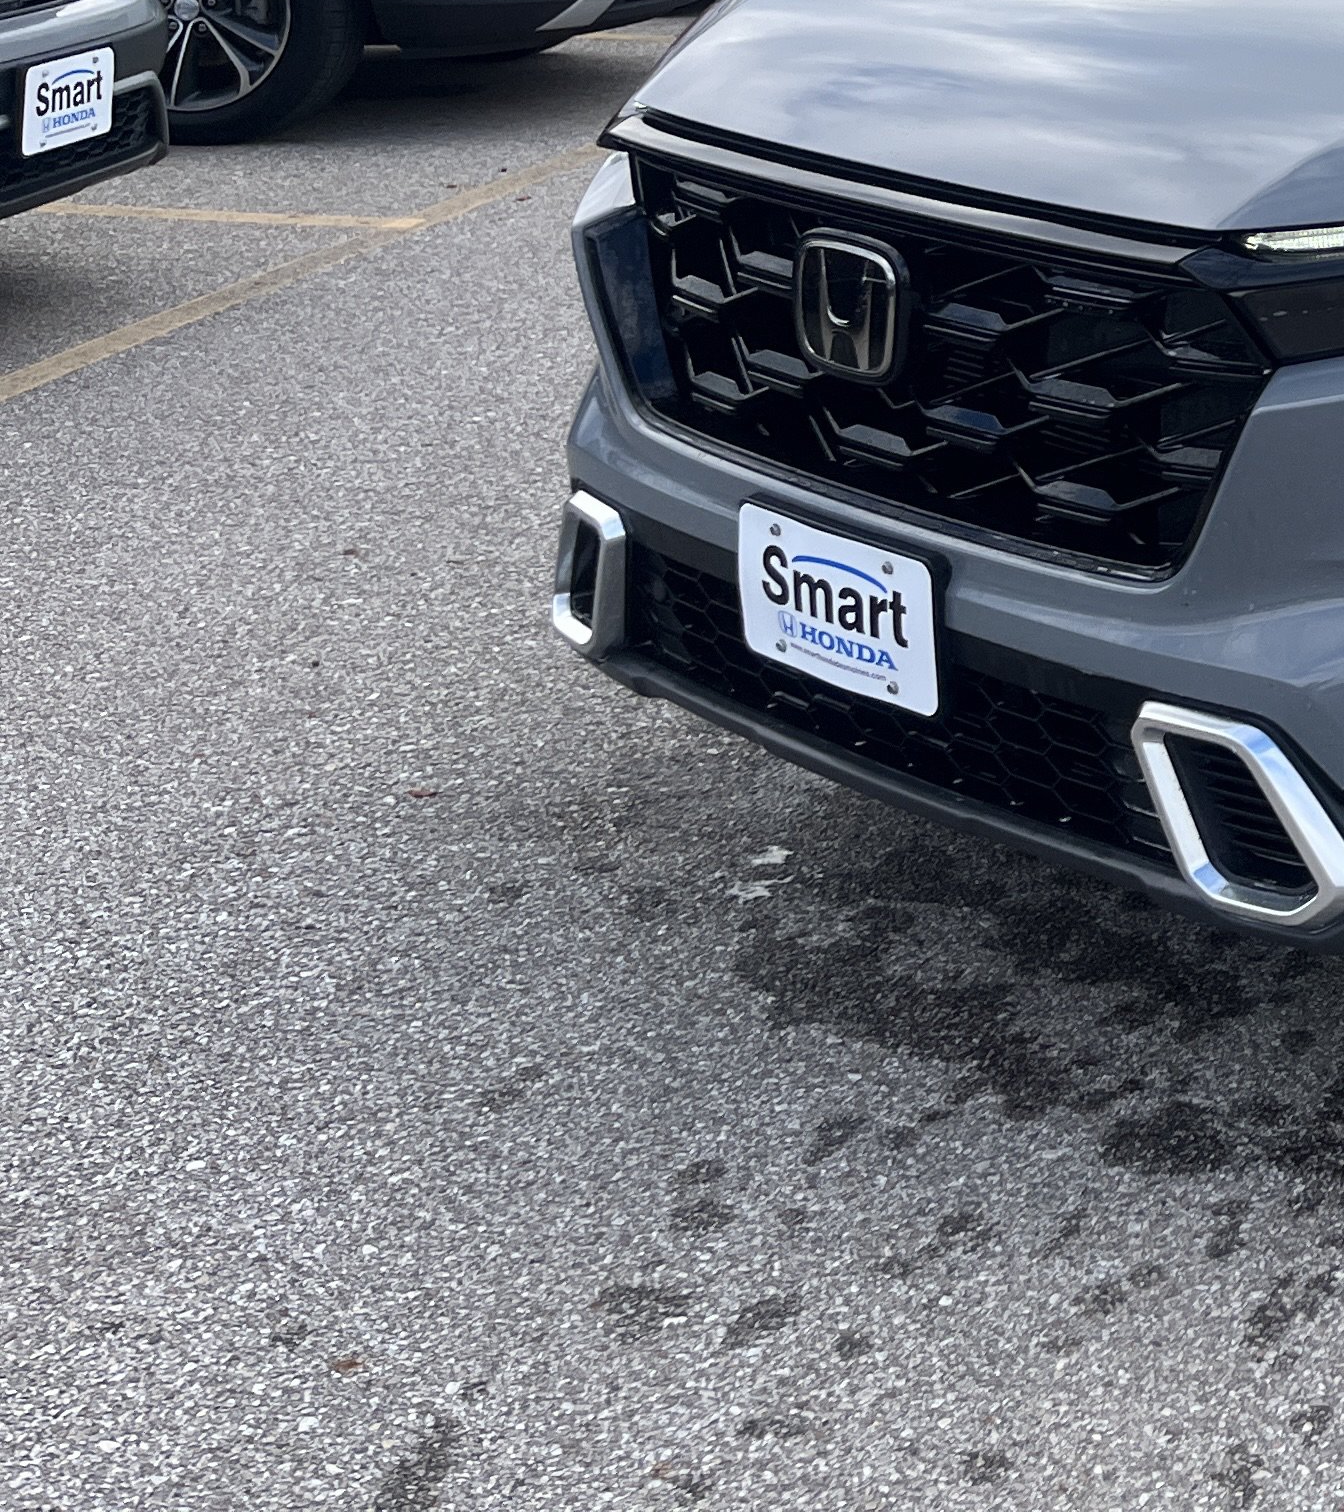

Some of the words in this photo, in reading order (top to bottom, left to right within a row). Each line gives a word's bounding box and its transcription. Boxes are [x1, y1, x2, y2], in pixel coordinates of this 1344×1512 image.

[36, 70, 103, 116] Smart
[52, 107, 96, 129] HONDA
[762, 545, 908, 649] Smart
[799, 621, 899, 672] HONDA
